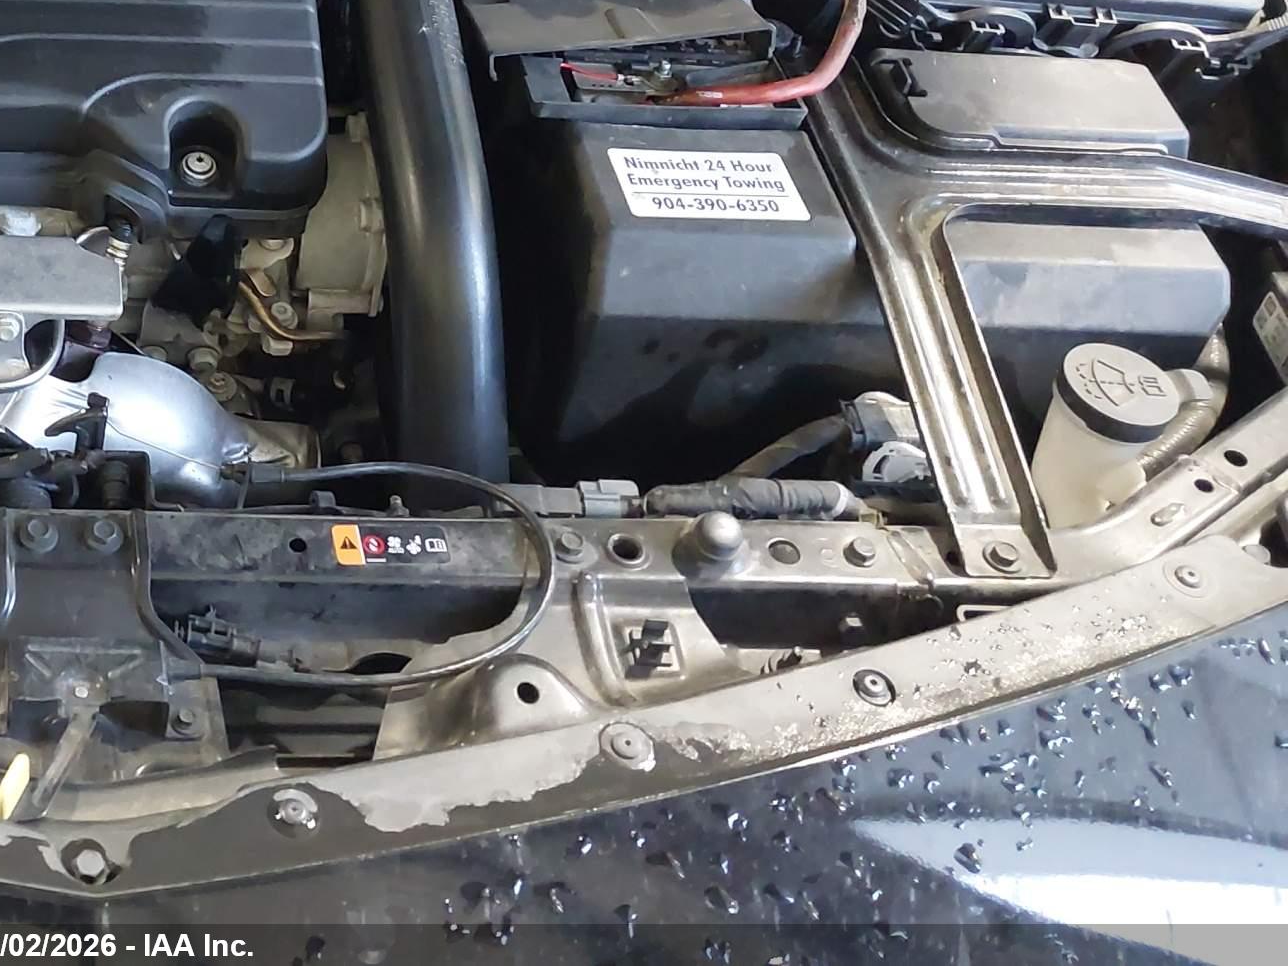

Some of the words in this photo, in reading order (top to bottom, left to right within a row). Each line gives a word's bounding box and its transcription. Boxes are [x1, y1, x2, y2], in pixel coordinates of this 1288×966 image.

[624, 156, 700, 171] Nimnicht
[704, 160, 726, 171] 24
[731, 160, 772, 172] Hour
[627, 173, 719, 190] Emergency
[723, 176, 785, 193] Towing
[652, 196, 780, 212] 904-390-6350
